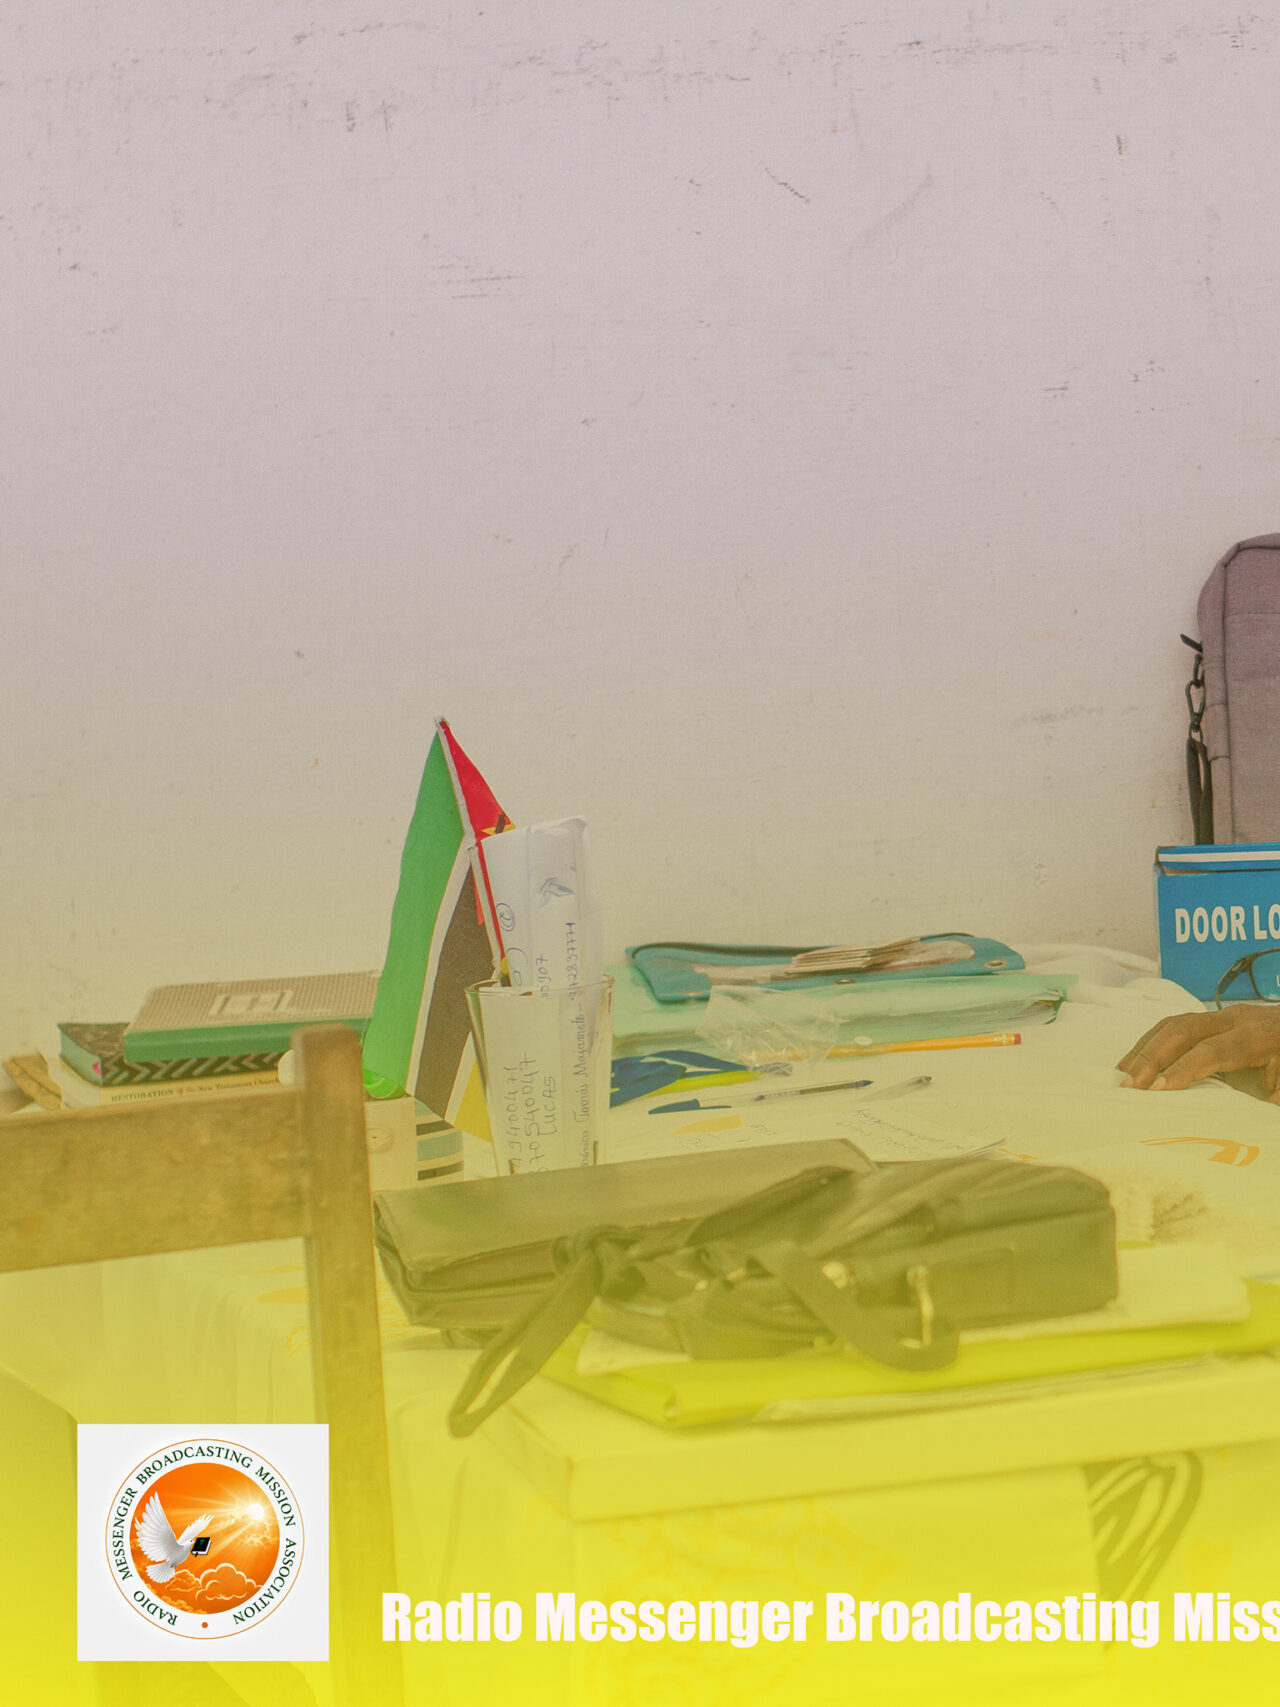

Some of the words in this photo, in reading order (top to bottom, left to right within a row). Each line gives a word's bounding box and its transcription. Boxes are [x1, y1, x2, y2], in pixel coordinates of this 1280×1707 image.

[1175, 905, 1247, 943] DOOR
[111, 1089, 174, 1102] RESTORATION
[215, 1082, 253, 1090] Testament
